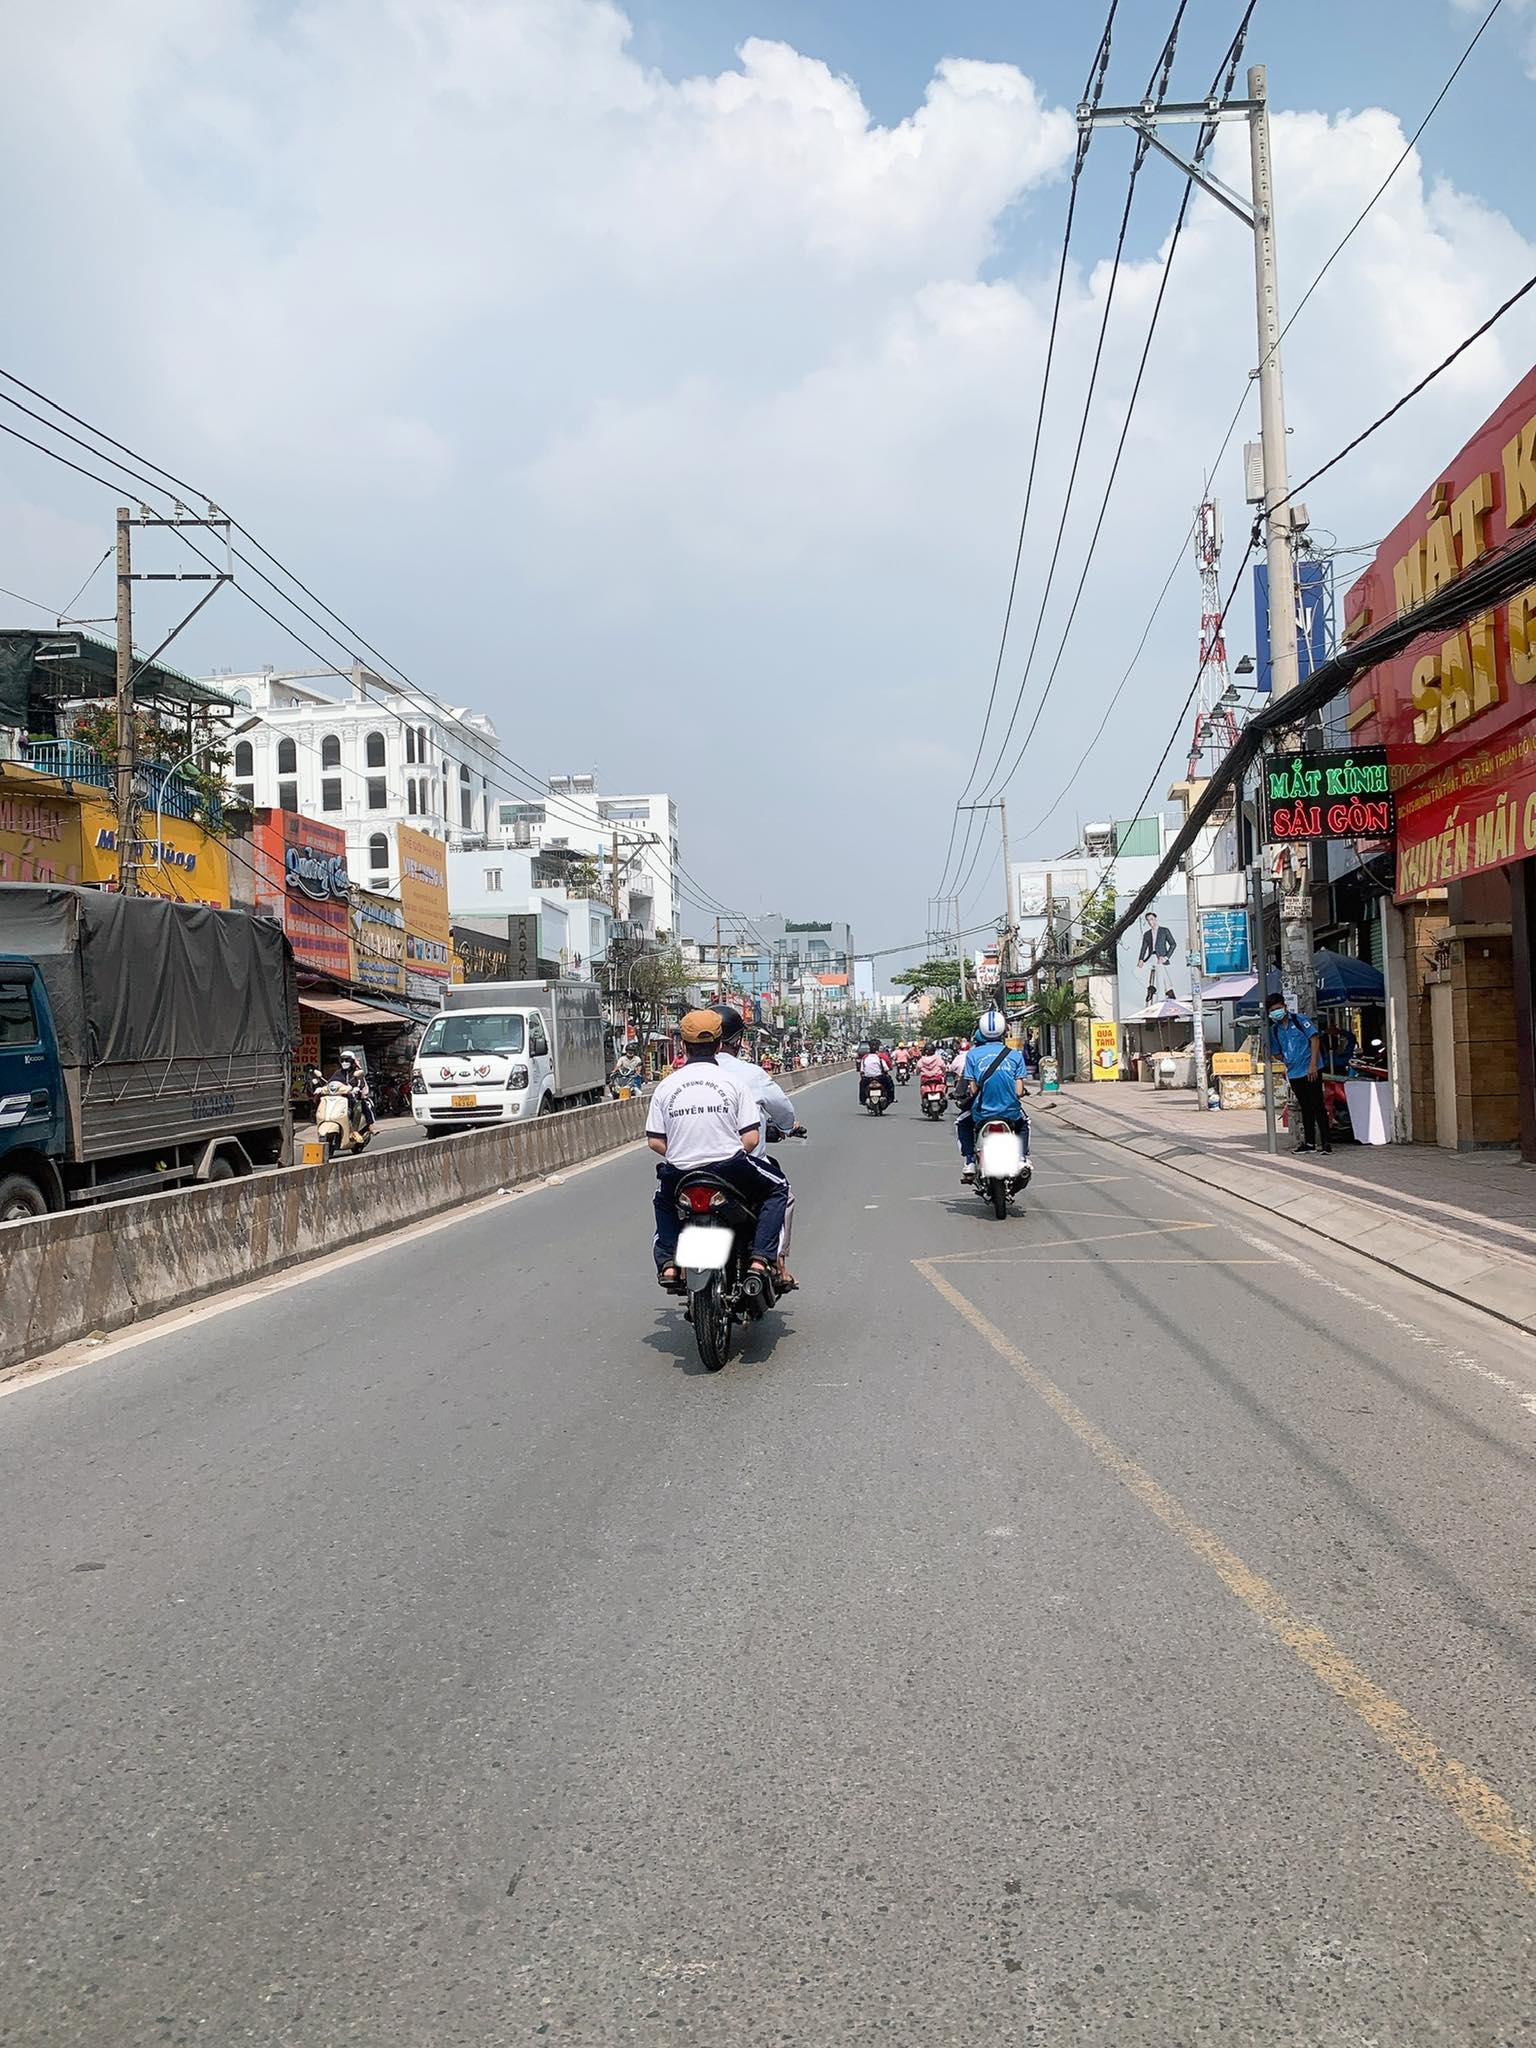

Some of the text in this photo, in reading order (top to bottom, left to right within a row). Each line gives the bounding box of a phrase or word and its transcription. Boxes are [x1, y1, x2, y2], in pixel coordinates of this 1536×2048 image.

[1393, 474, 1493, 626] MẮT
[1269, 758, 1321, 799] MẮT
[1326, 759, 1388, 796] KÍNH
[1273, 796, 1389, 837] SÀI GÒN
[1399, 805, 1470, 896] KHUYẾN
[1474, 791, 1517, 869] MÃI
[681, 1080, 704, 1090] TRUNG
